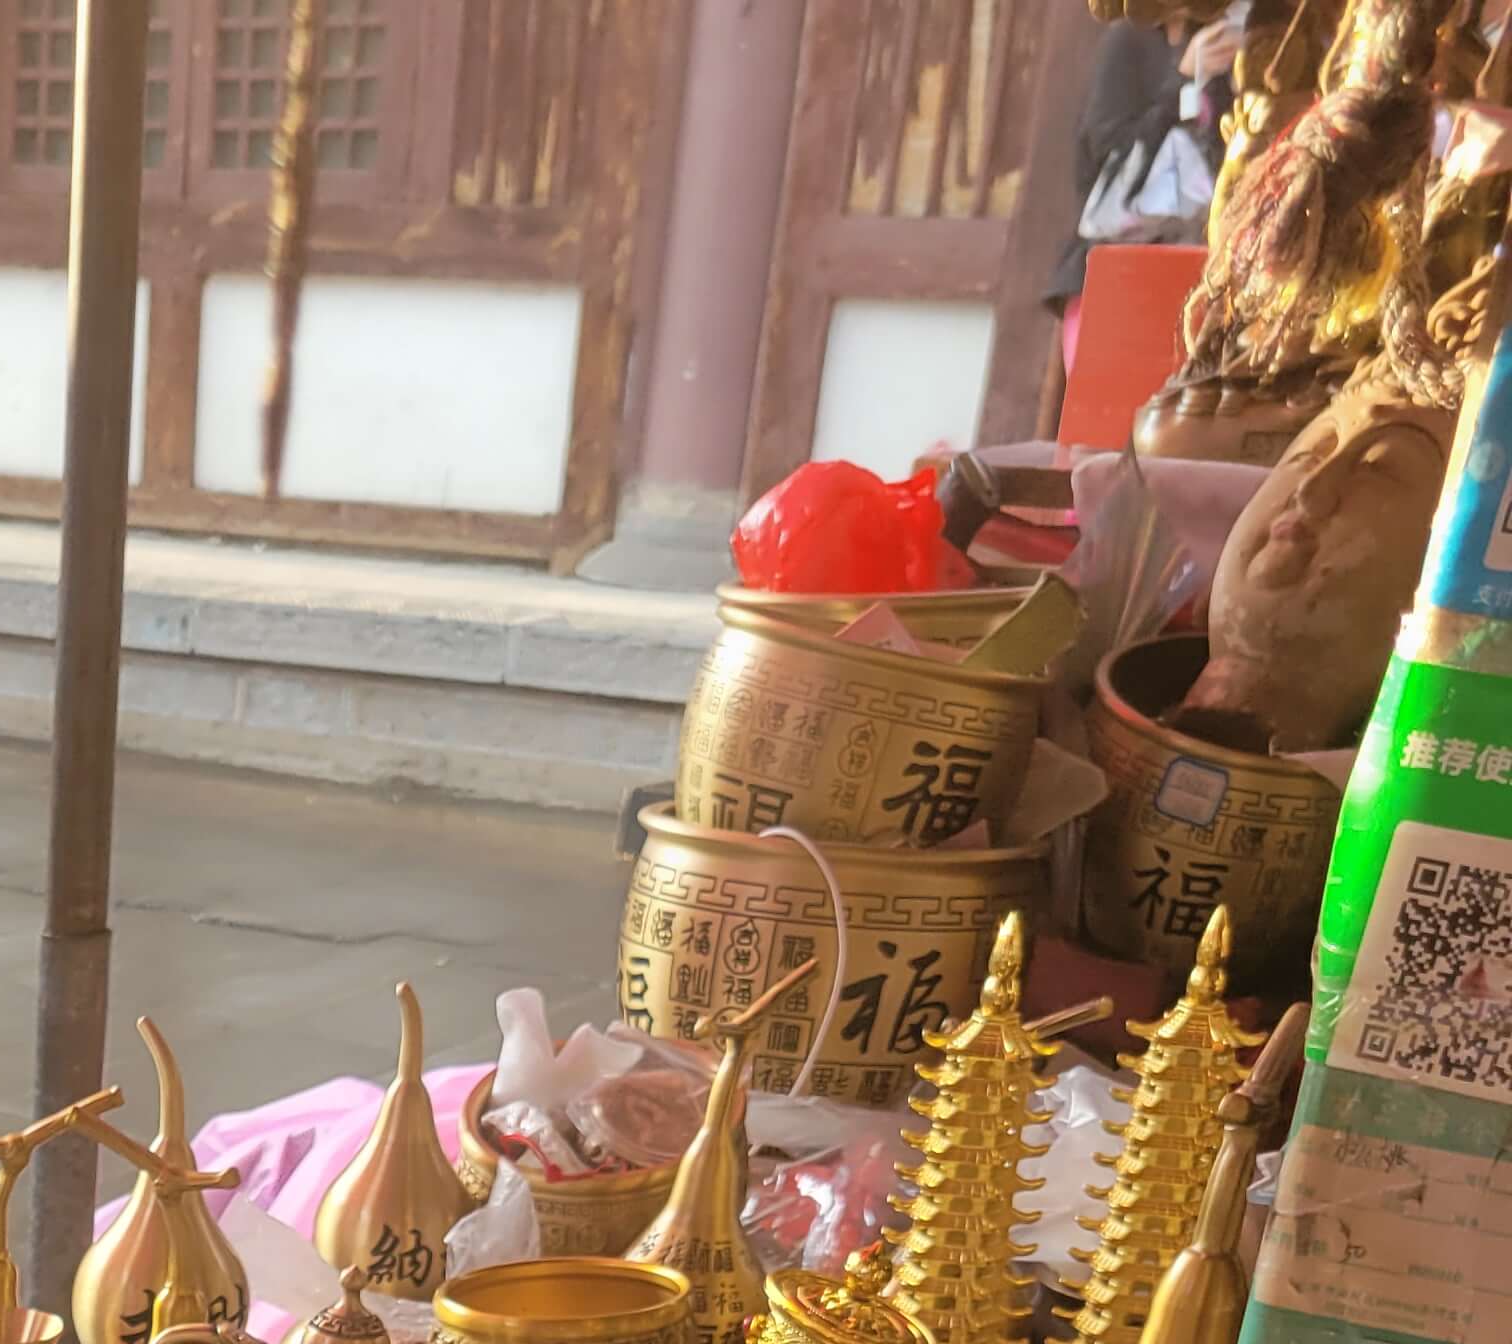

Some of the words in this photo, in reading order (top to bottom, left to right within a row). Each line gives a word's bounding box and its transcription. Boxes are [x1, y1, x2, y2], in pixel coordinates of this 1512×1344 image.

[882, 740, 992, 848] 福
[1129, 846, 1232, 938] 福
[840, 941, 949, 1055] 福
